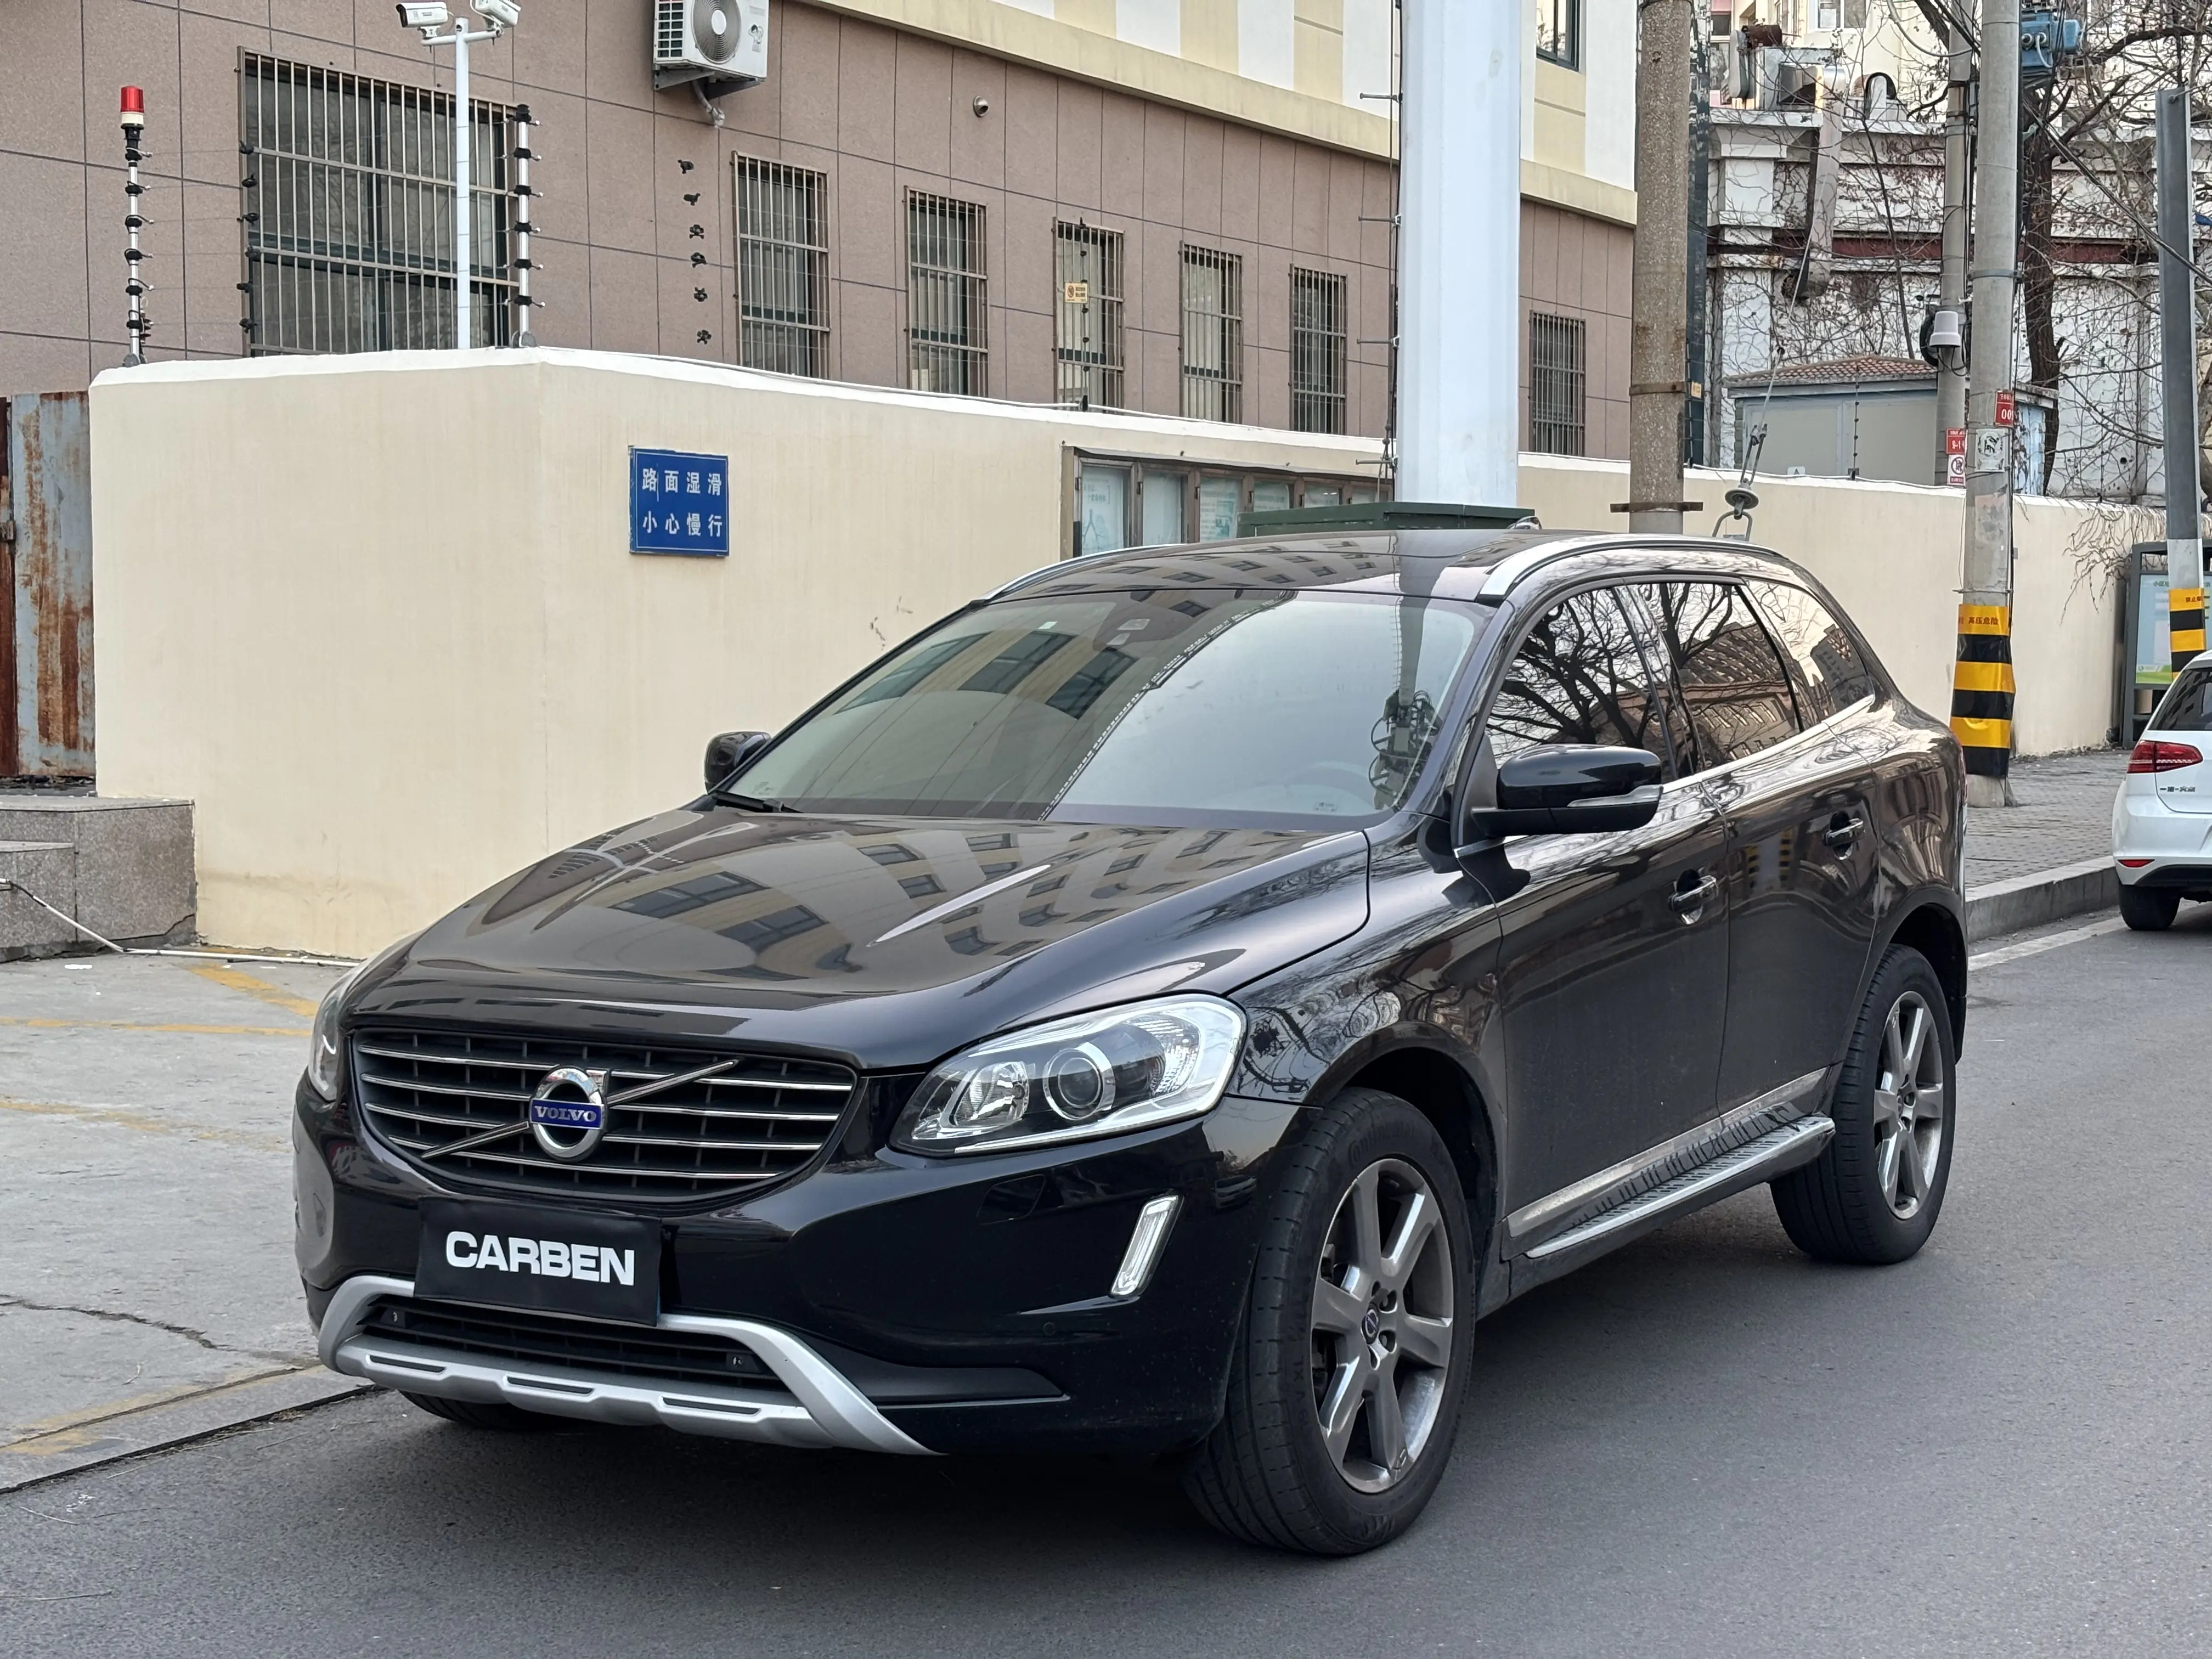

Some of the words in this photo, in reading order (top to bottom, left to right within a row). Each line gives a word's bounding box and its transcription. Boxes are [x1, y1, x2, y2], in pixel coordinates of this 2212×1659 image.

[642, 468, 721, 496] 路面湿滑
[642, 511, 723, 537] 小心慢行
[1968, 617, 1999, 625] 高压危险
[534, 1105, 597, 1122] VOLVO
[446, 1231, 635, 1286] CARBEN
